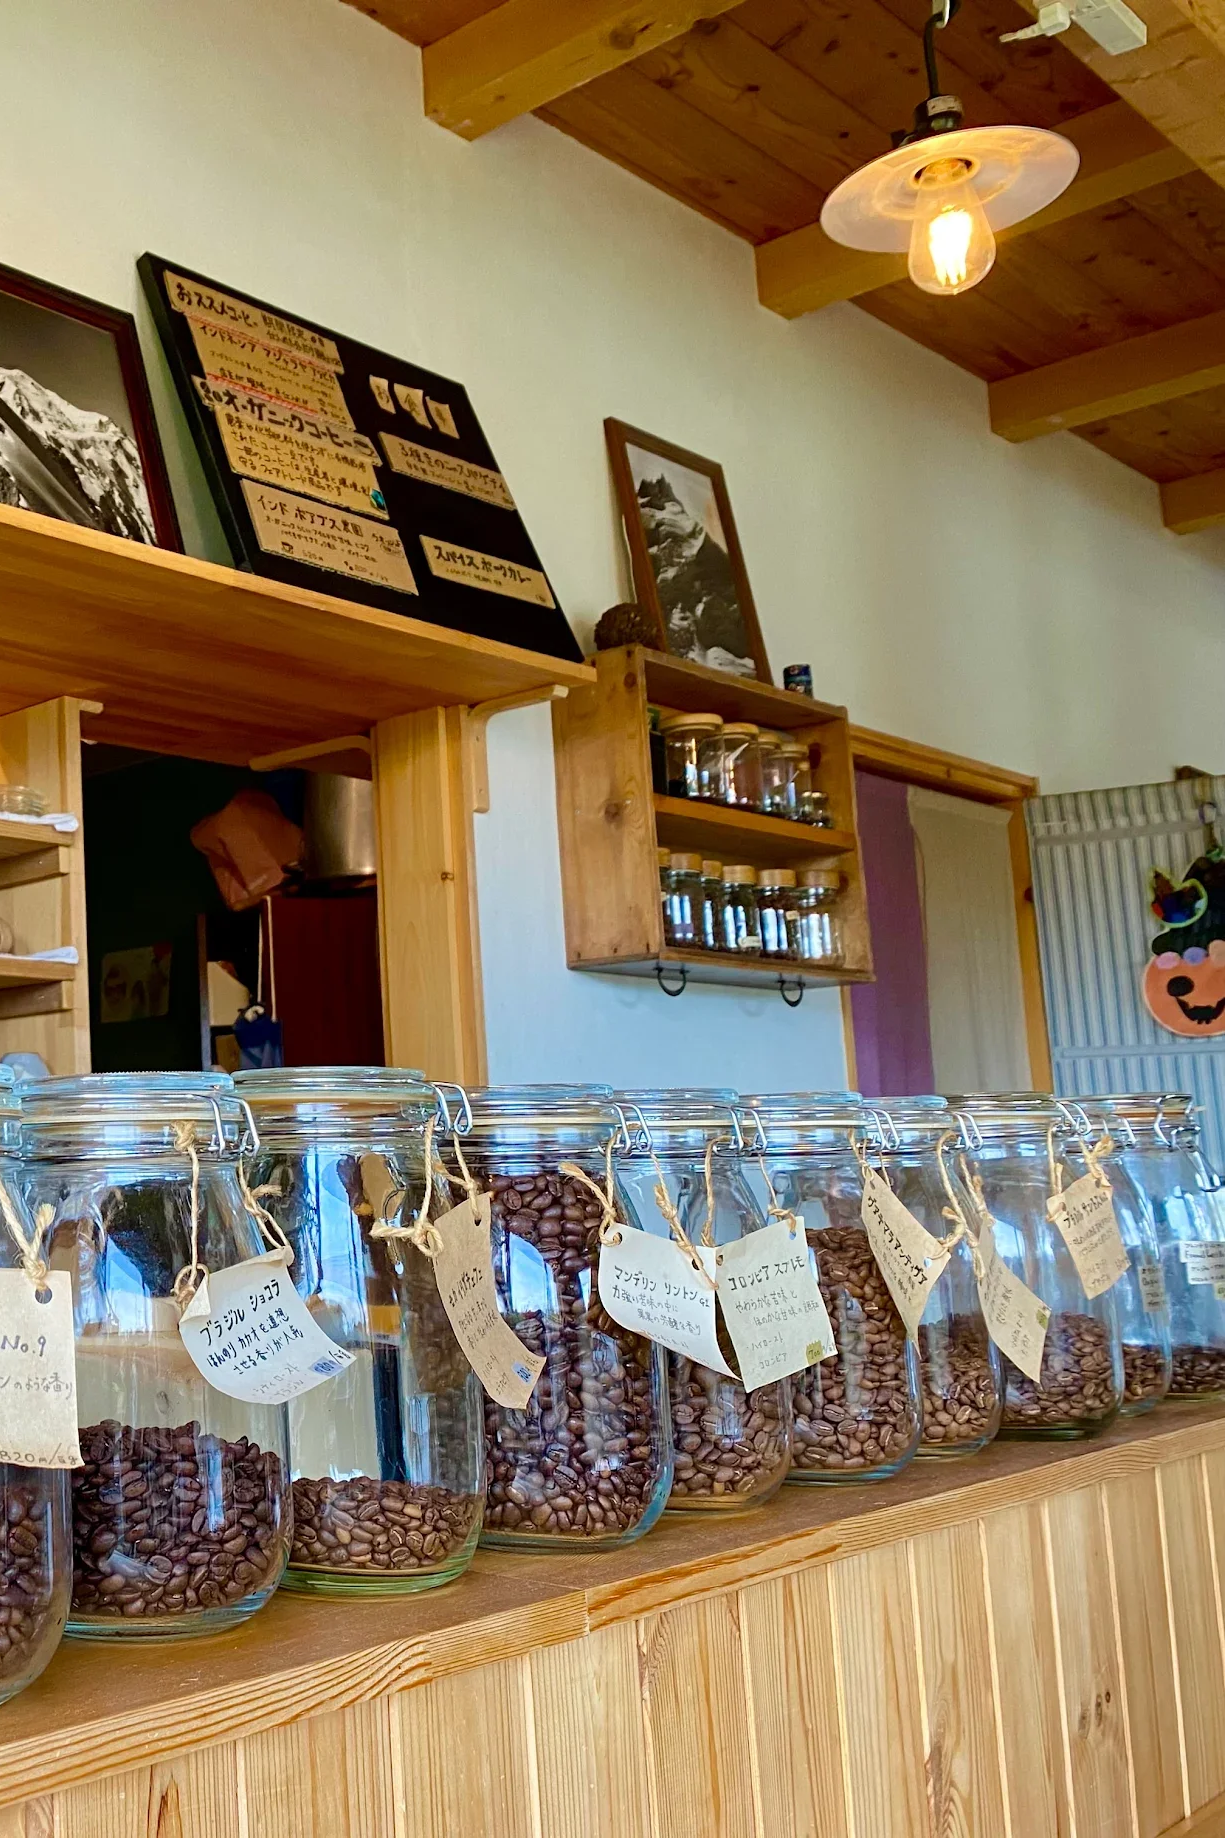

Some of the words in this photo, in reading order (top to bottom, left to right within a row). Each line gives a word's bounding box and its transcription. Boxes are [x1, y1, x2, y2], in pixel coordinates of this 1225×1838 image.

[257, 495, 290, 516] インド
[613, 1265, 657, 1291] マンデリン
[664, 1283, 698, 1301] リントン
[728, 1265, 770, 1290] コロンビア
[773, 1255, 805, 1278] スプレモ
[200, 1308, 245, 1346] ブラジル
[249, 1278, 281, 1312] ショコラ
[0, 1334, 48, 1357] No.9
